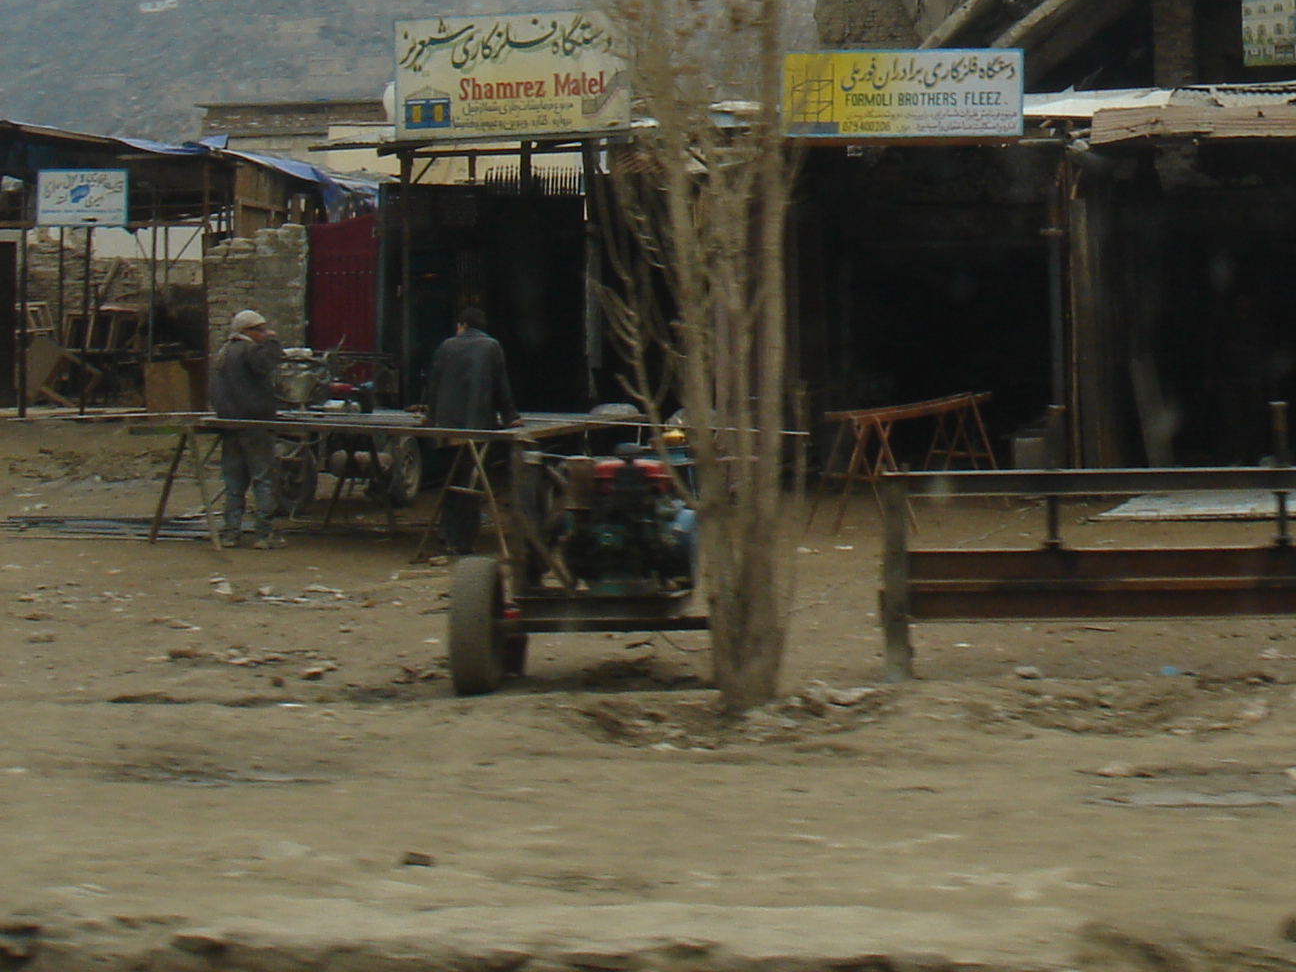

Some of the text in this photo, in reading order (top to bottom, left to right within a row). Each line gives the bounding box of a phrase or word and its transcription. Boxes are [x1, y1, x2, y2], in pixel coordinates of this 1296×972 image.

[872, 56, 924, 90] برادران
[924, 56, 978, 89] فلزکاری
[979, 55, 1016, 80] دستگاه
[458, 70, 606, 102] Shamrez Matel
[844, 91, 893, 107] FORMOLI
[898, 91, 957, 107] BROTHERS
